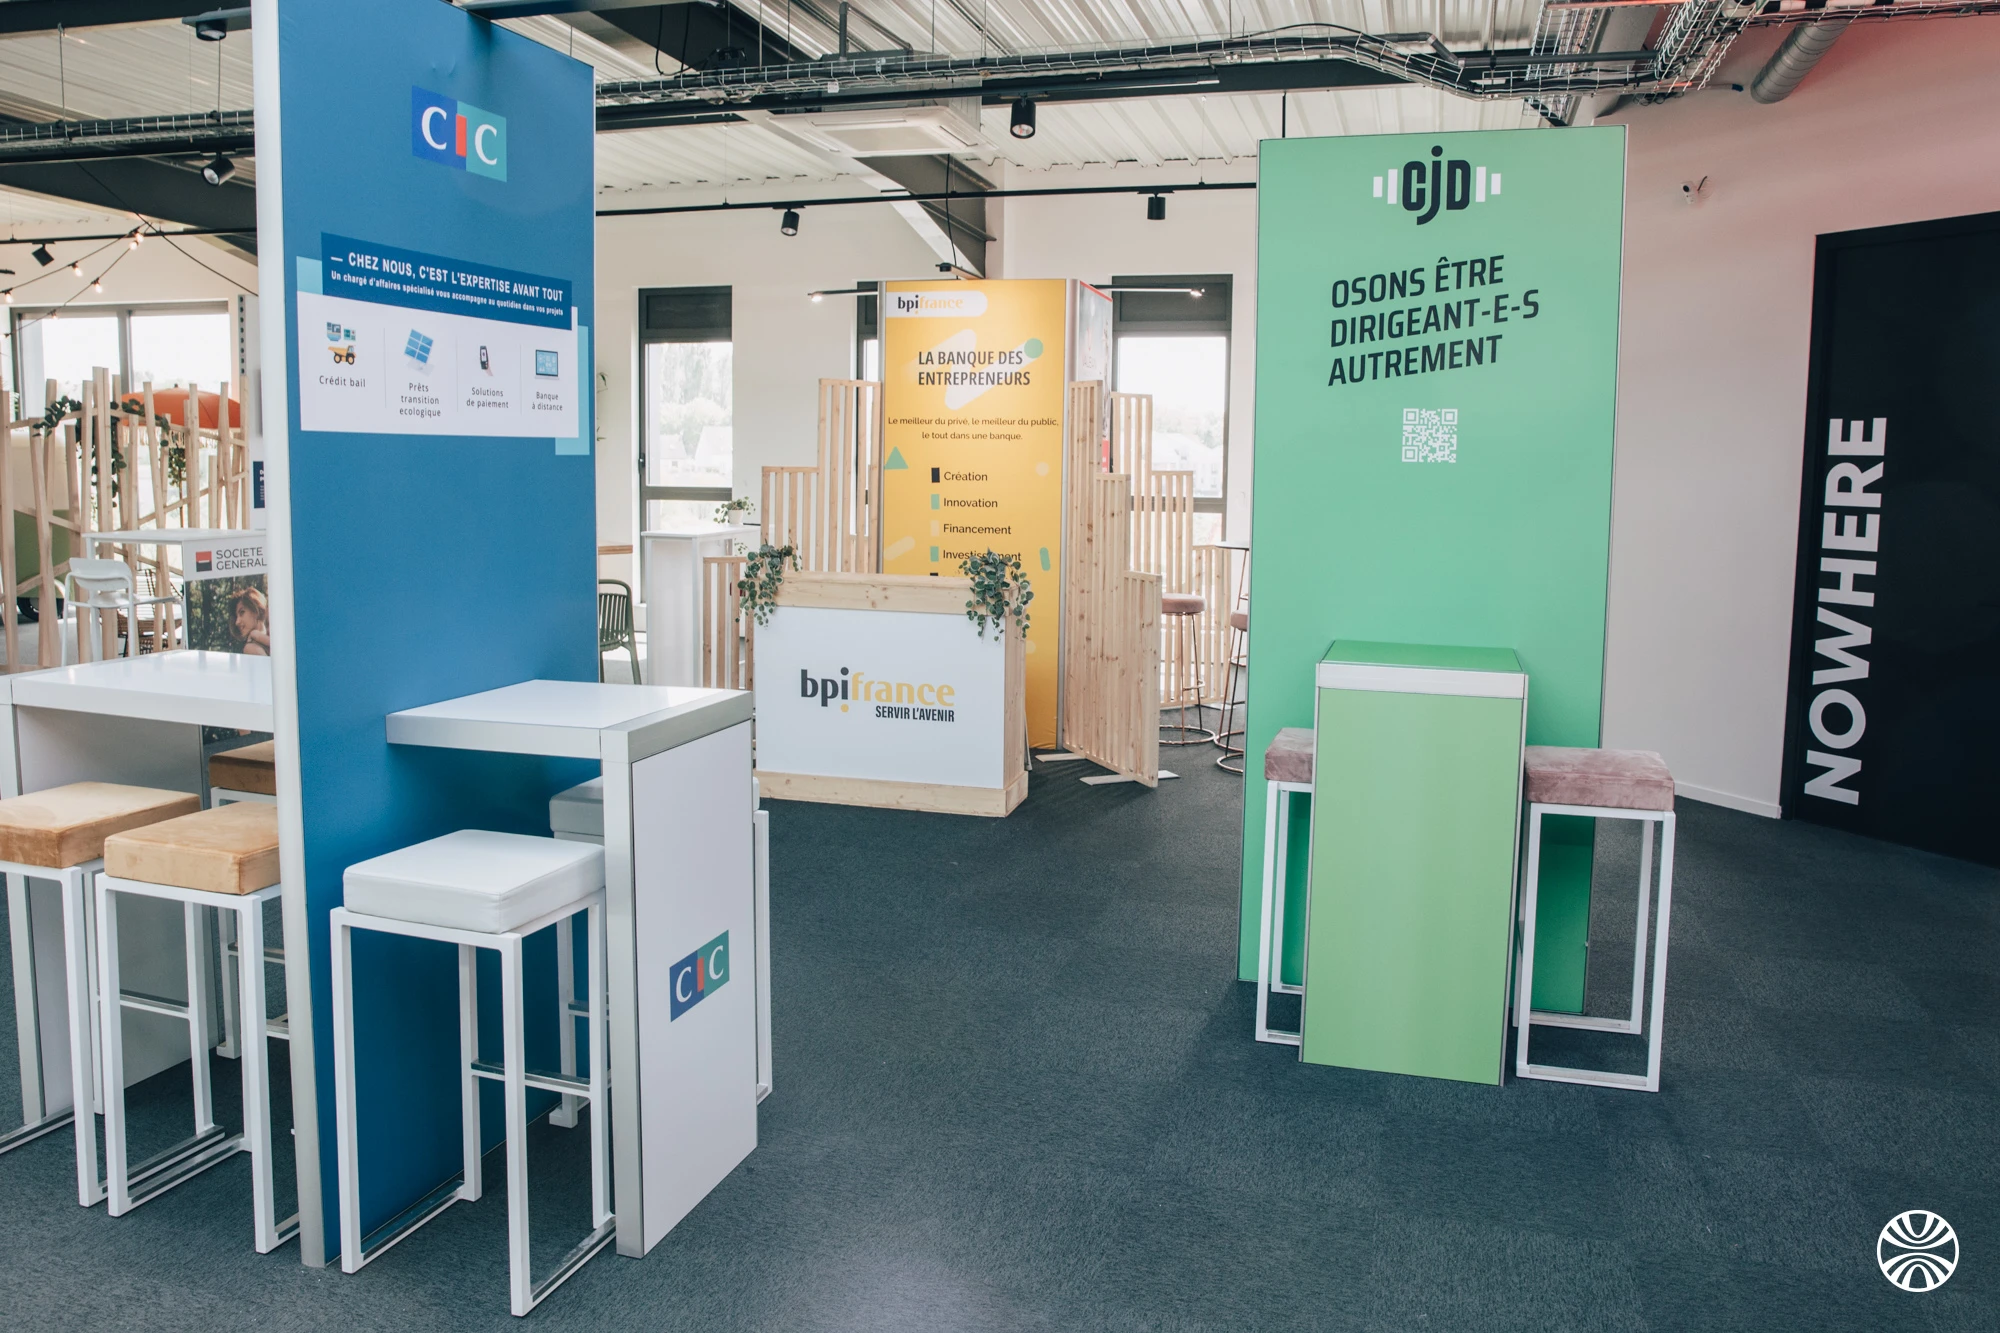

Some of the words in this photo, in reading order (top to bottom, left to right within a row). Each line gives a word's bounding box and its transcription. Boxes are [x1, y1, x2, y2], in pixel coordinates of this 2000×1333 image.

[421, 105, 498, 166] CIC
[348, 252, 379, 270] CHEZ
[382, 258, 416, 279] NOUS,
[419, 265, 449, 283] C'EST
[451, 271, 510, 293] L'EXPERTISE
[512, 282, 540, 298] AVANT
[542, 287, 564, 302] TOUT
[1331, 267, 1426, 309] OSONS
[1435, 254, 1505, 293] ÊTRE
[331, 270, 342, 281] Un
[343, 273, 368, 287] chargé
[369, 278, 401, 290] d'affaires
[402, 283, 435, 296] spécialisé
[436, 289, 451, 299] vous
[452, 291, 487, 304] accompagne
[488, 297, 496, 306] au
[496, 299, 522, 311] quotidien
[522, 302, 535, 312] dans
[536, 306, 546, 314] vos
[546, 307, 564, 317] projets
[897, 294, 964, 314] bpifrance
[1330, 289, 1539, 348] DIRIGEANT-E-S
[918, 351, 934, 365] LA
[938, 350, 994, 367] BANQUE
[998, 351, 1023, 365] DES
[1327, 334, 1503, 387] AUTREMENT
[319, 375, 347, 387] Crédit
[349, 377, 366, 388] bail
[918, 371, 1031, 386] ENTREPRENEURS
[408, 382, 429, 393] Prêts
[471, 386, 504, 398] Solutions
[400, 394, 440, 405] transition
[535, 391, 559, 402] Banque
[466, 398, 475, 407] de
[477, 399, 509, 409] paiement
[531, 402, 536, 410] à
[537, 402, 563, 412] distance
[399, 406, 442, 419] ecologique
[888, 416, 898, 425] Le
[899, 417, 933, 426] meilleur
[934, 416, 946, 426] du
[947, 417, 970, 427] privé,
[971, 417, 979, 426] le
[981, 417, 1016, 427] meilleur
[1017, 418, 1029, 427] du
[1030, 417, 1059, 428] public,
[921, 431, 930, 440] le
[931, 431, 948, 440] tout
[949, 431, 970, 441] dans
[971, 432, 988, 441] une
[989, 432, 1023, 442] banque.
[943, 471, 988, 482] Création
[943, 497, 998, 509] Innovation
[943, 523, 1012, 535] Financement
[216, 546, 263, 560] SOCIETE
[943, 549, 1022, 561] Investissment
[1804, 417, 1887, 806] NOWHERE
[800, 666, 955, 713] bpifrance
[875, 705, 910, 720] SERVIR
[676, 945, 724, 1003] CIC
